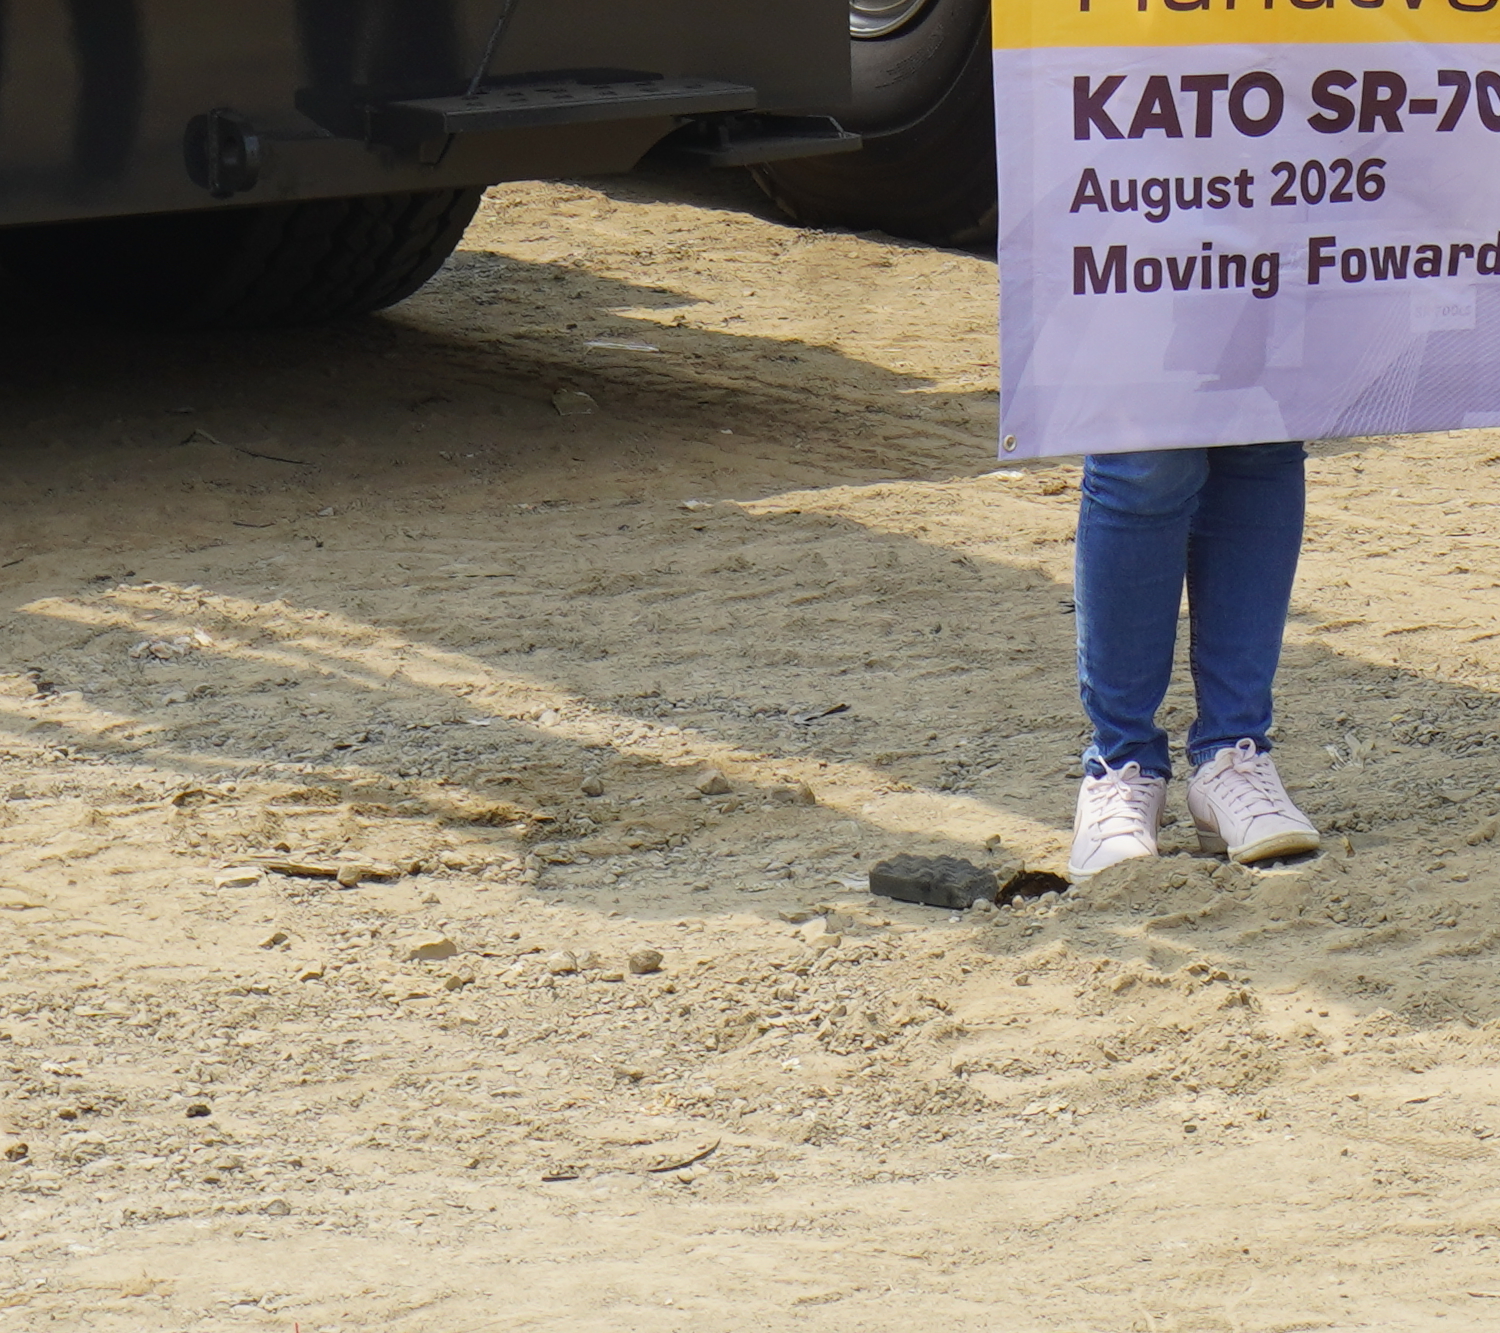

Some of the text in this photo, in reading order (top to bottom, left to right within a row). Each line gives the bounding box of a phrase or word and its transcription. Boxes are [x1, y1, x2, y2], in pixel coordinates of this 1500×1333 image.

[1072, 70, 1287, 141] KATO
[1070, 158, 1387, 225] August 2026
[1072, 240, 1281, 300] Moving
